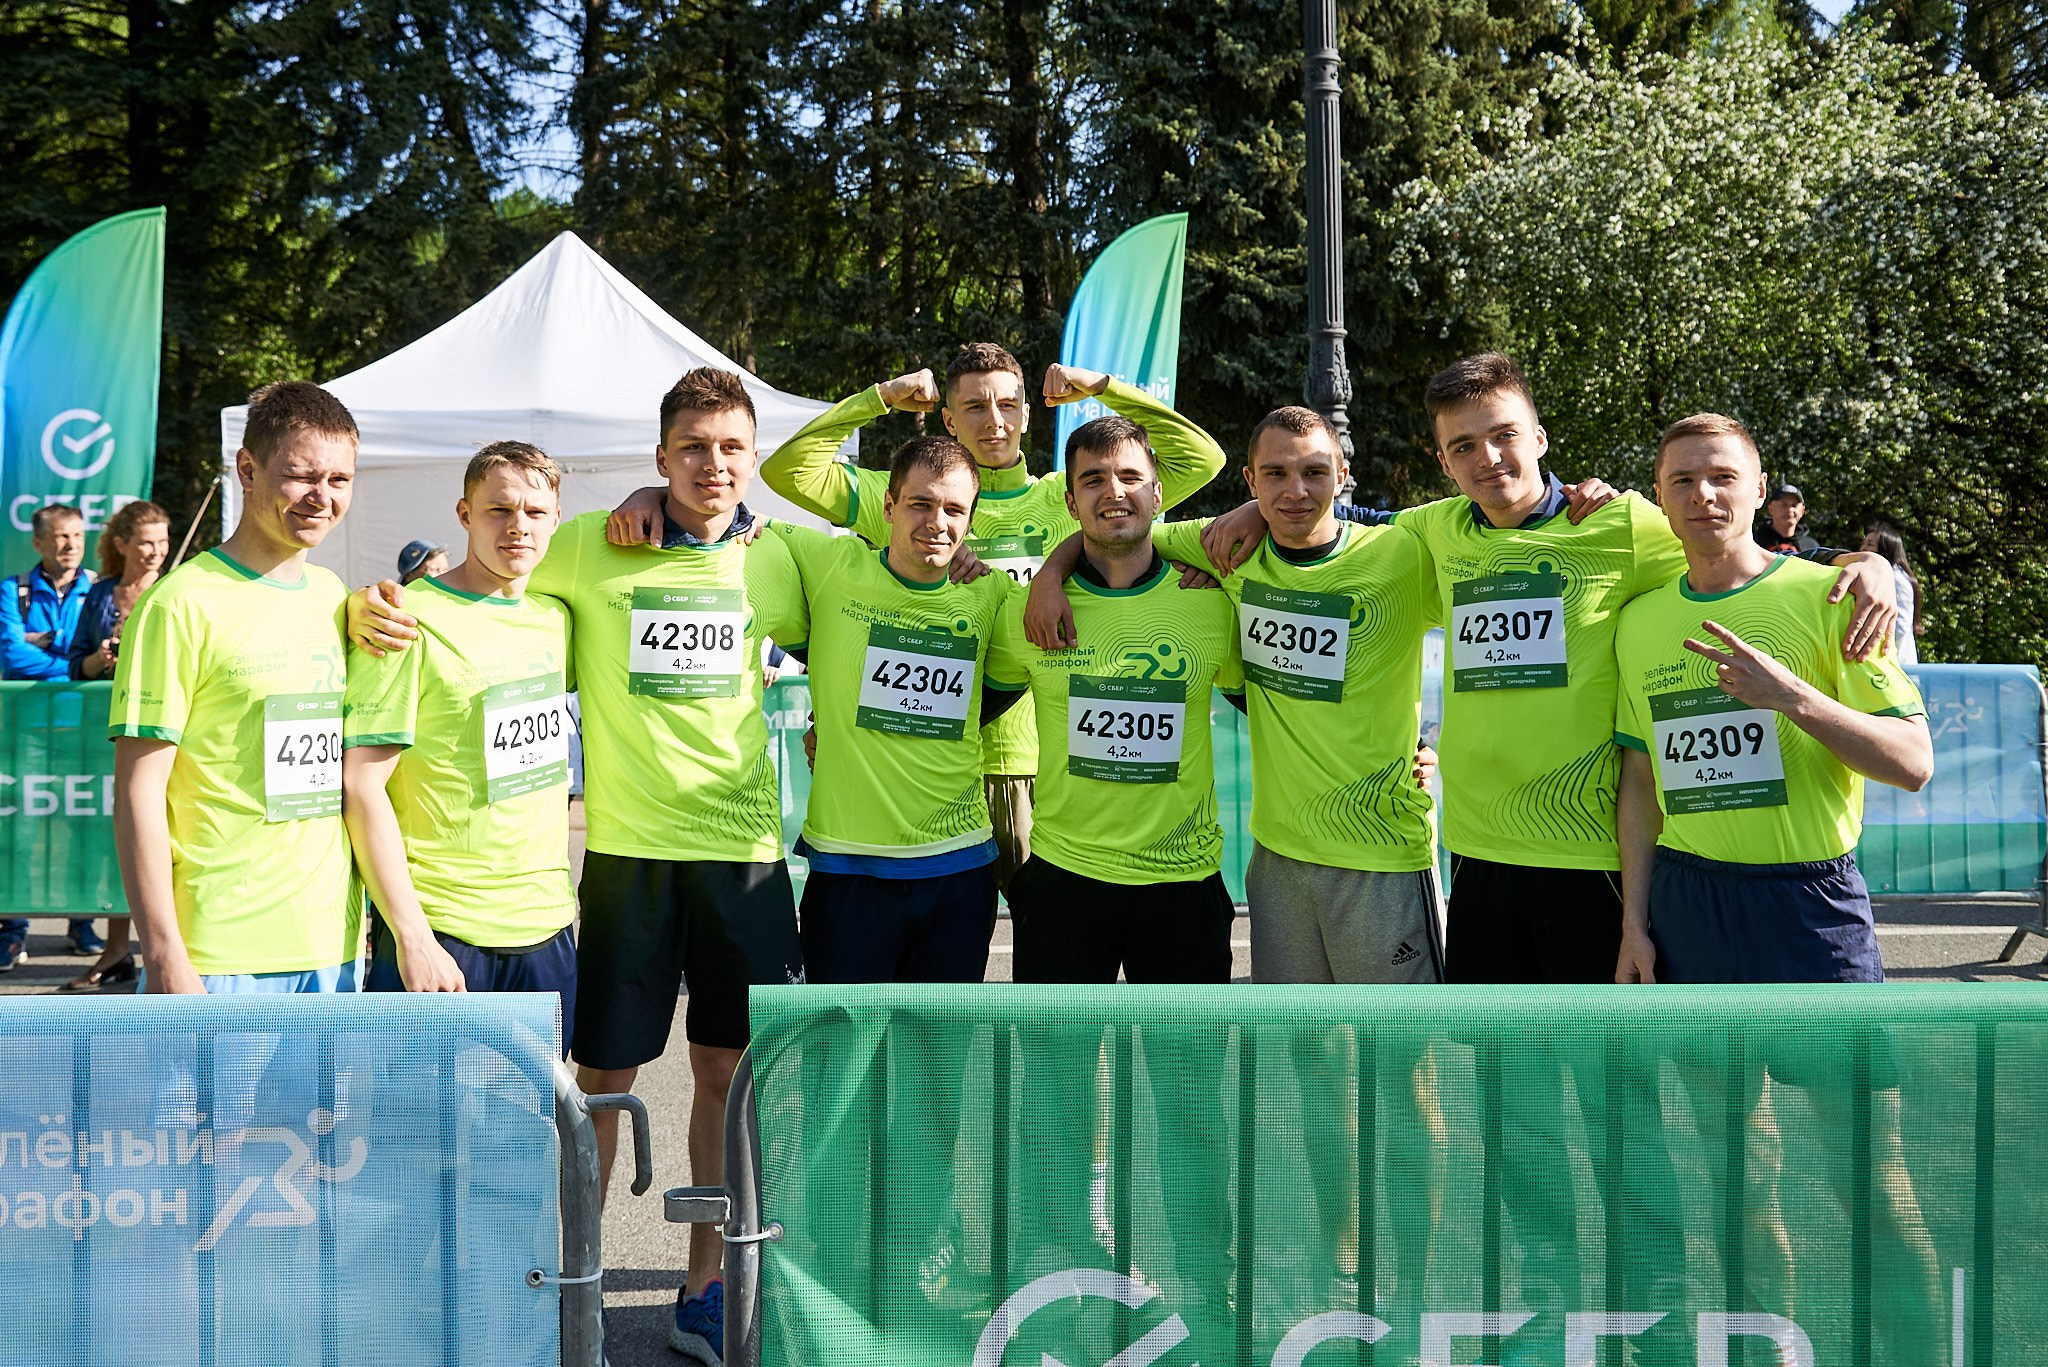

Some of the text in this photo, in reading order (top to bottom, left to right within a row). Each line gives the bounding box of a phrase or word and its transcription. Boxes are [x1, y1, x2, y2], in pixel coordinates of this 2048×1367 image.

[850, 599, 901, 620] зелёный
[640, 622, 734, 651] 42308
[1247, 617, 1338, 658] 42302
[1459, 609, 1553, 645] 42307
[871, 659, 964, 698] 42304
[1036, 657, 1090, 669] марафон
[1644, 658, 1687, 680] зелёный
[1642, 675, 1683, 693] марафон
[494, 709, 560, 750] 42303
[1077, 709, 1175, 741] 42305
[277, 732, 343, 767] 4230
[1664, 722, 1764, 764] 42309
[1391, 950, 1421, 966] adidas
[0, 1173, 188, 1241] афон
